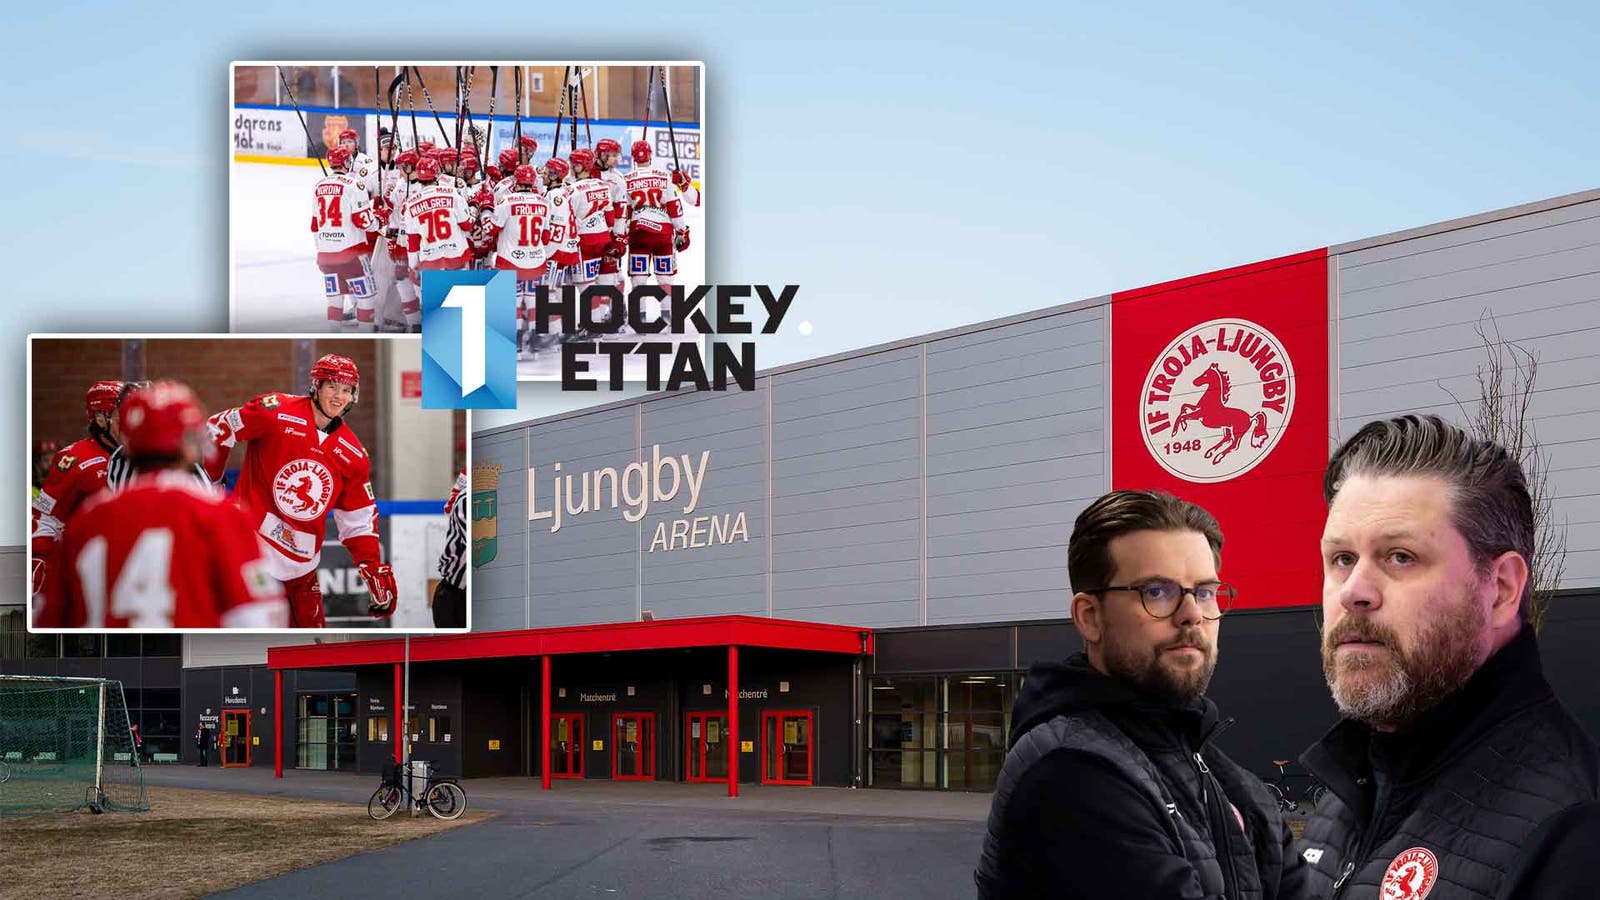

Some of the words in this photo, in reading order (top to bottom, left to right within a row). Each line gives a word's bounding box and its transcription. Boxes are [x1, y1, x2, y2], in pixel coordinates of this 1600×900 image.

[418, 209, 452, 243] 76
[518, 216, 543, 247] 16
[1148, 327, 1287, 415] TROJA-LJUNGBY
[1147, 410, 1172, 436] IF
[1164, 439, 1201, 455] 1948
[528, 444, 710, 533] Ljungby
[649, 511, 749, 553] ARENA
